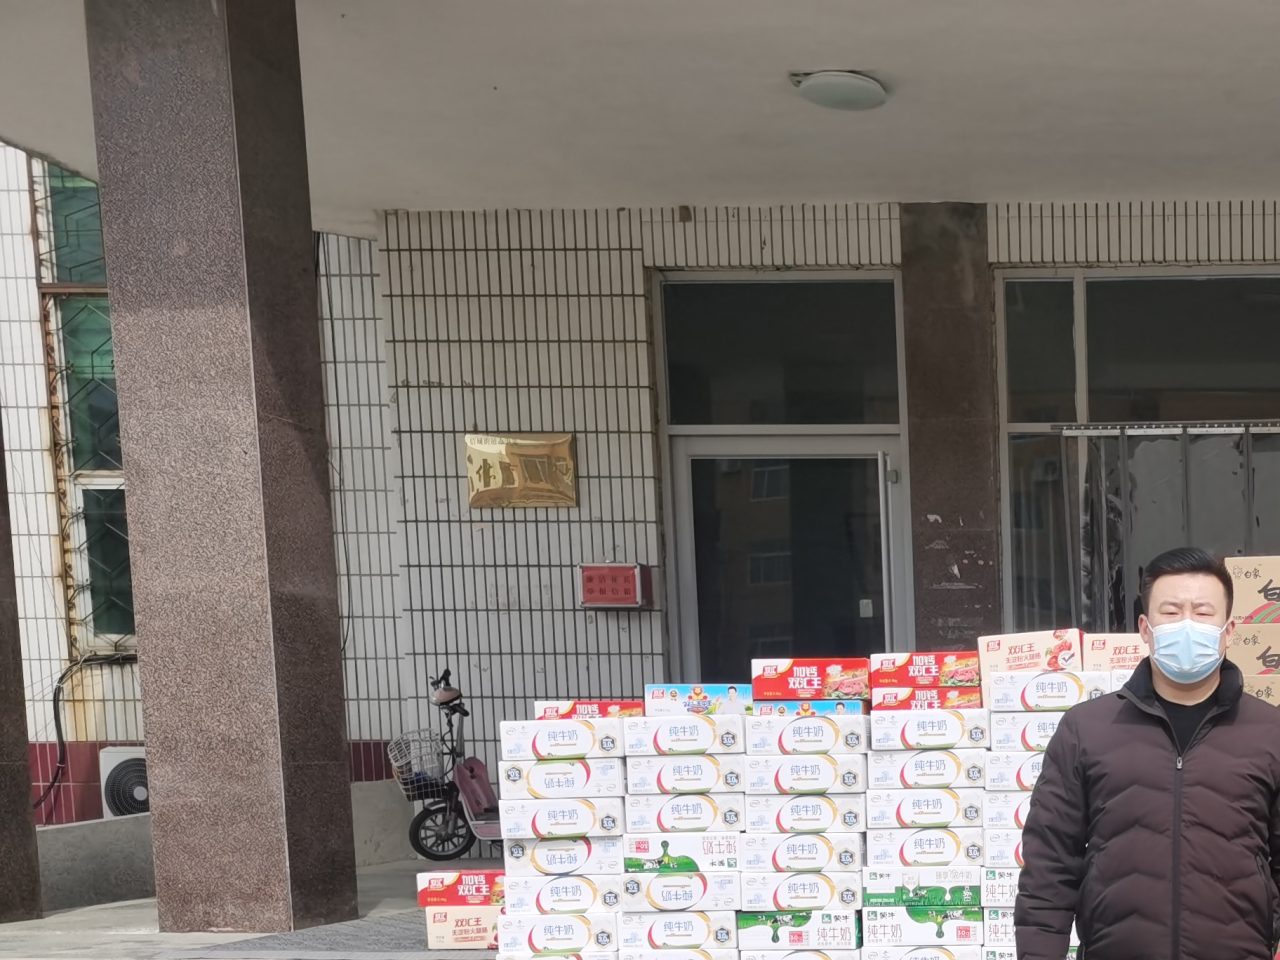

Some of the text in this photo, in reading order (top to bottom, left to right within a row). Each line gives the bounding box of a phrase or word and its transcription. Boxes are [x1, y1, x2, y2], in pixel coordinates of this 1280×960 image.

[1008, 643, 1035, 655] 双汇王
[1113, 645, 1140, 655] 双汇王
[912, 656, 935, 666] 加钙
[793, 667, 818, 678] 加钙
[908, 665, 939, 676] 双汇王
[788, 677, 822, 688] 双汇王
[1035, 682, 1068, 693] 纯牛奶
[915, 690, 938, 700] 加钙
[668, 725, 699, 737] 纯牛奶
[917, 720, 947, 731] 纯牛奶
[1037, 722, 1056, 732] 纯牛
[547, 730, 578, 742] 纯牛奶
[792, 726, 824, 738] 纯牛奶
[672, 765, 703, 776] 纯牛奶
[790, 765, 821, 776] 纯牛奶
[914, 760, 946, 771] 纯牛奶
[671, 803, 702, 815] 纯牛奶
[912, 799, 942, 810] 纯牛奶
[547, 809, 579, 821] 纯牛奶
[790, 805, 822, 816] 纯牛奶
[914, 838, 945, 849] 纯牛奶
[786, 844, 818, 855] 纯牛奶
[462, 875, 485, 885] 加钙
[458, 885, 490, 895] 双汇王
[550, 886, 582, 897] 纯牛奶
[788, 882, 819, 894] 纯牛奶
[455, 918, 482, 927] 双汇王
[663, 921, 694, 932] 纯牛奶
[544, 925, 574, 936] 纯牛奶
[817, 928, 851, 942] 纯牛奶
[867, 924, 902, 938] 纯牛奶
